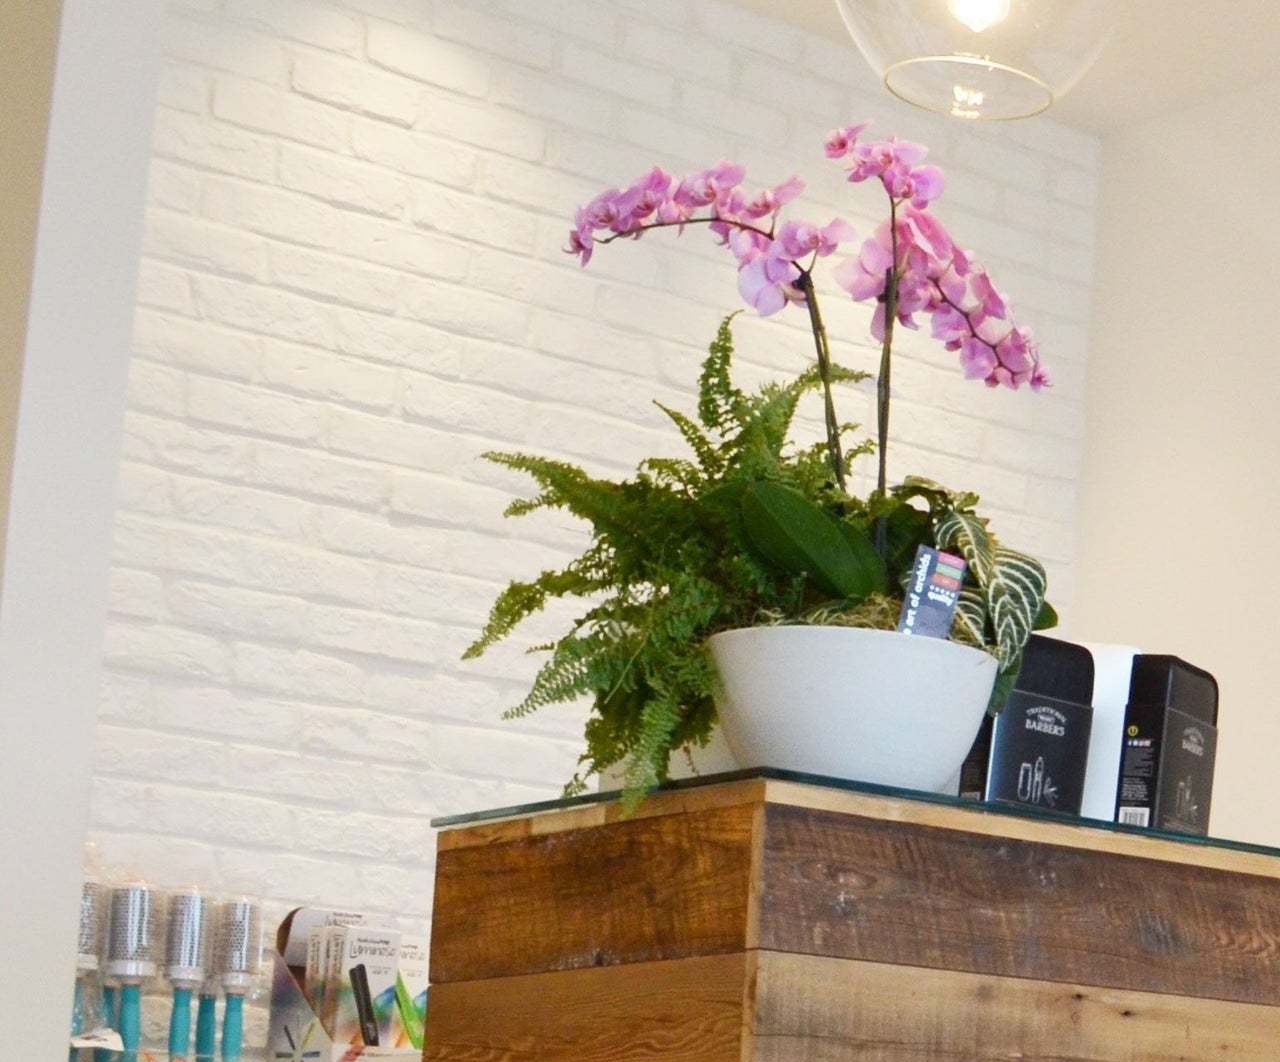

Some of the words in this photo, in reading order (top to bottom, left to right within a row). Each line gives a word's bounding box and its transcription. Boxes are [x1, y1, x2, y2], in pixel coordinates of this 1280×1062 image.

[915, 553, 931, 593] orchids
[909, 592, 920, 608] of
[906, 609, 917, 627] art
[1025, 719, 1065, 737] BARBERS
